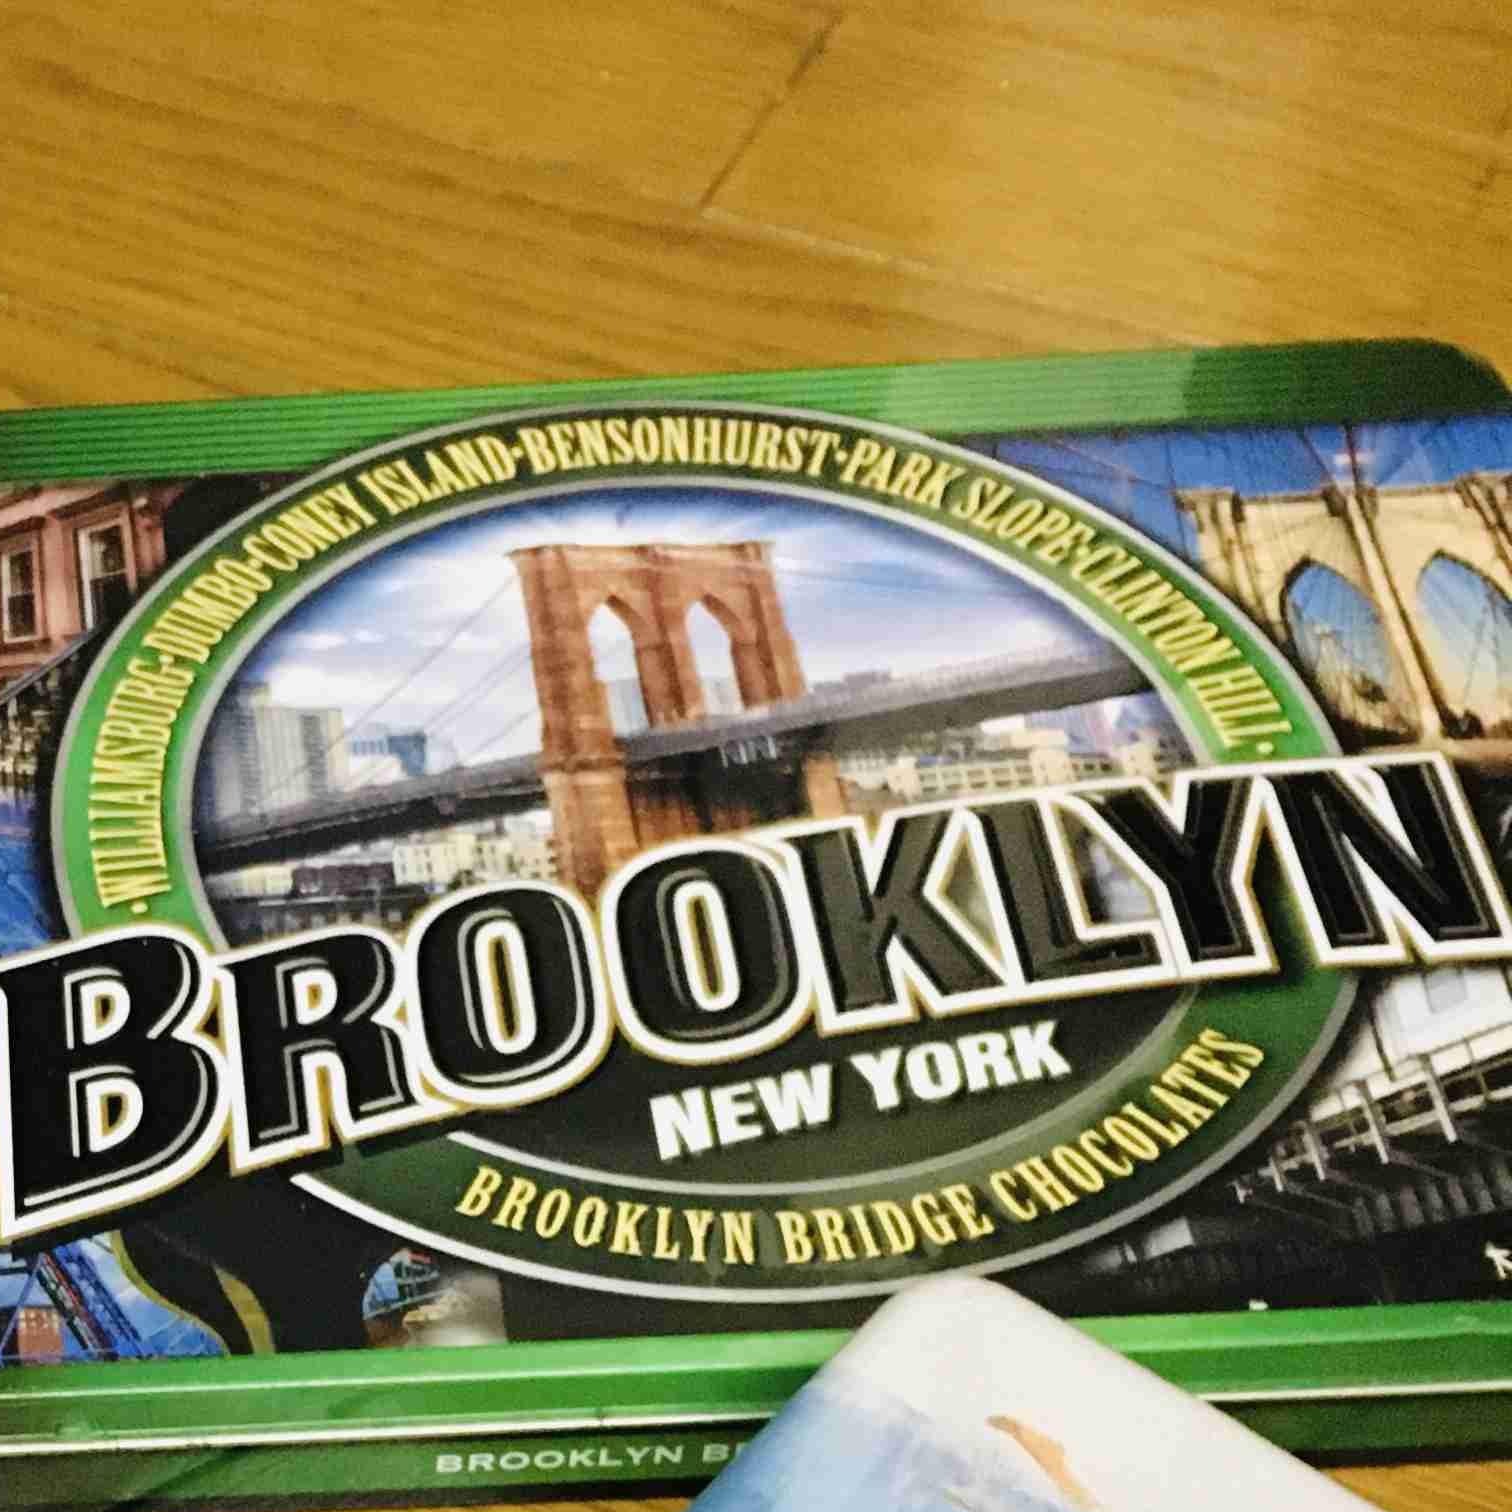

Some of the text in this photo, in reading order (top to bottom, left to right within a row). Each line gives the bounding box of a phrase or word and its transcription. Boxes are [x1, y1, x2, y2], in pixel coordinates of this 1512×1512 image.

[88, 415, 1292, 909] WILLIAMSBURG DUMBO CONEY ISLAND BENSONHURST PARK SLOPE CLINTON HILL
[455, 1027, 1268, 1266] BROOKLYN BRIDGE CHOCOLATES
[650, 1020, 1072, 1162] NEW YORK
[435, 1443, 745, 1473] BROOKLYN B
